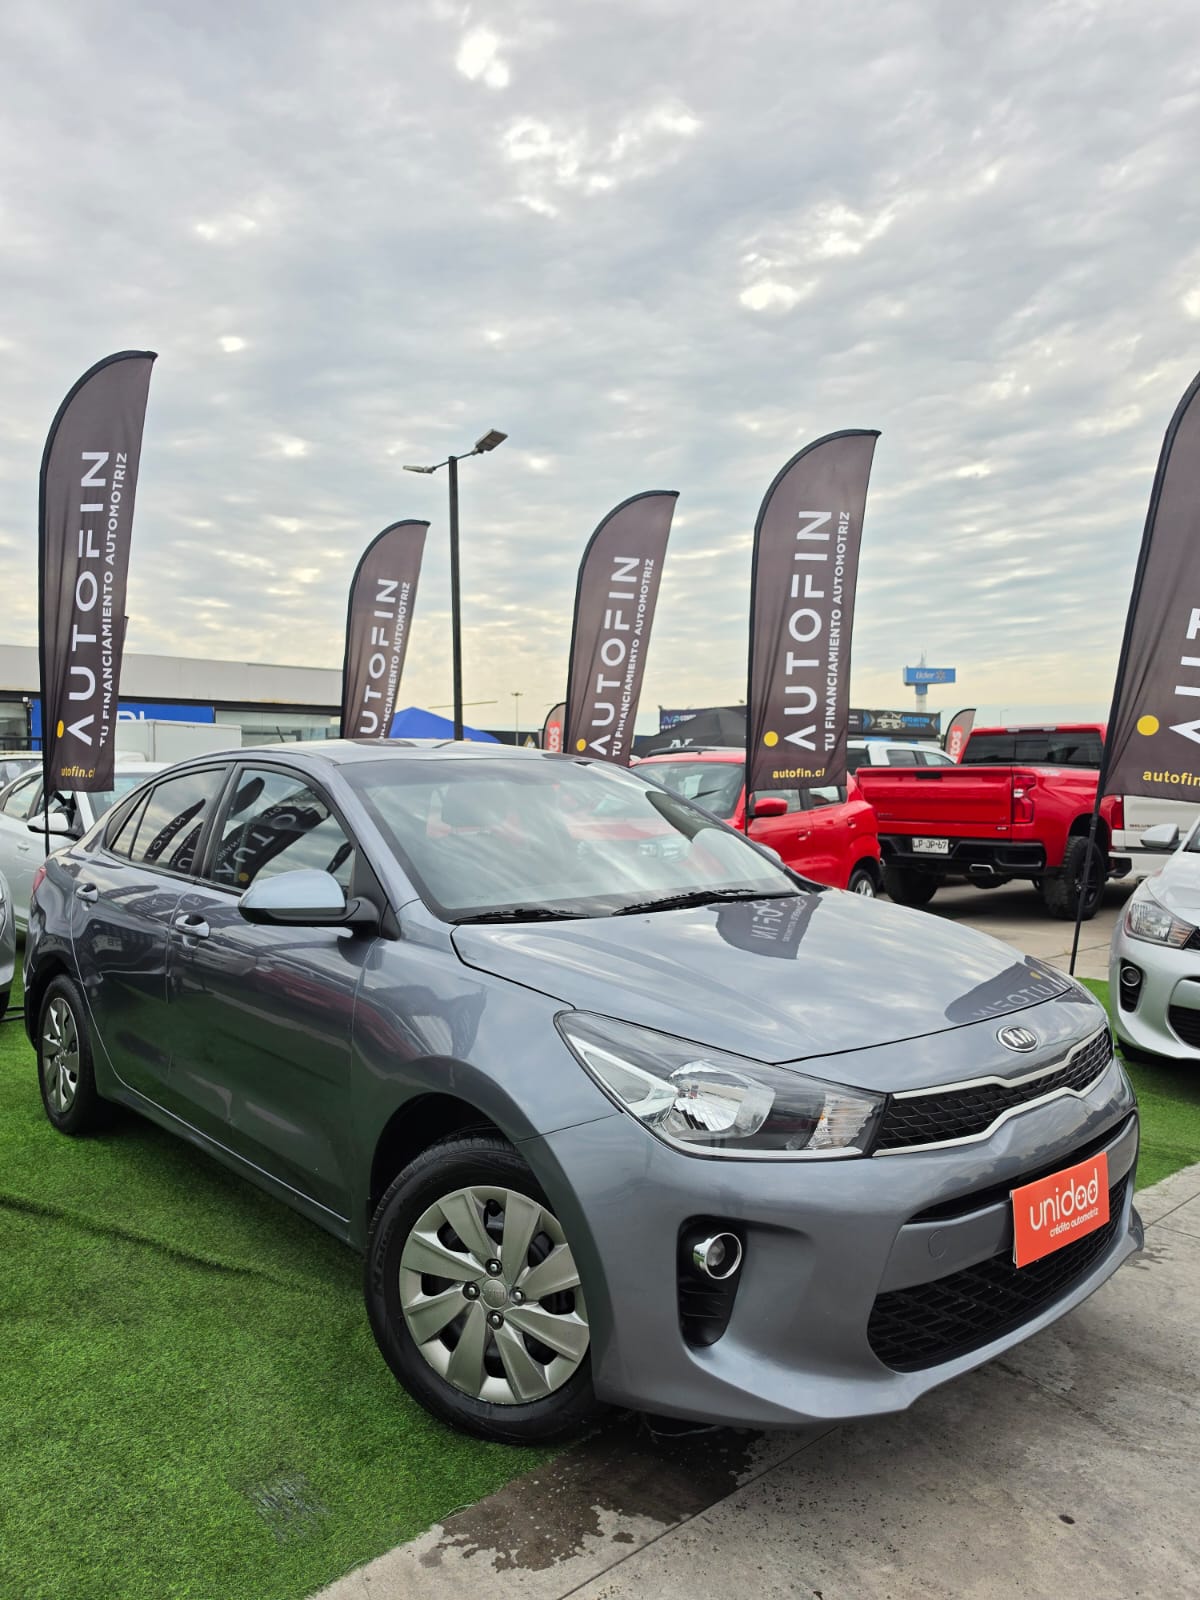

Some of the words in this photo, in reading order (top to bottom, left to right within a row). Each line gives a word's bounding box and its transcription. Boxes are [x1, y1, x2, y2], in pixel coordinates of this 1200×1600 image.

[105, 452, 127, 565] AUTOMOTRIZ
[832, 511, 850, 605] AUTOMOTRIZ
[67, 452, 109, 746] AUTOFIN
[102, 571, 113, 720] FINANCIAMIENTO
[360, 578, 399, 734] UTOFIN
[393, 581, 410, 653] AUTOMOTRIZ
[589, 556, 640, 756] AUTOFIN
[612, 743, 622, 756] TU
[634, 558, 655, 636] AUTOMOTRIZ
[784, 511, 832, 751] AUTOFIN
[825, 609, 842, 731] FINANCIAMIENTO
[99, 725, 109, 747] TU
[772, 762, 825, 779] autofin.cl
[825, 733, 835, 751] TU
[1029, 1167, 1099, 1232] unidad
